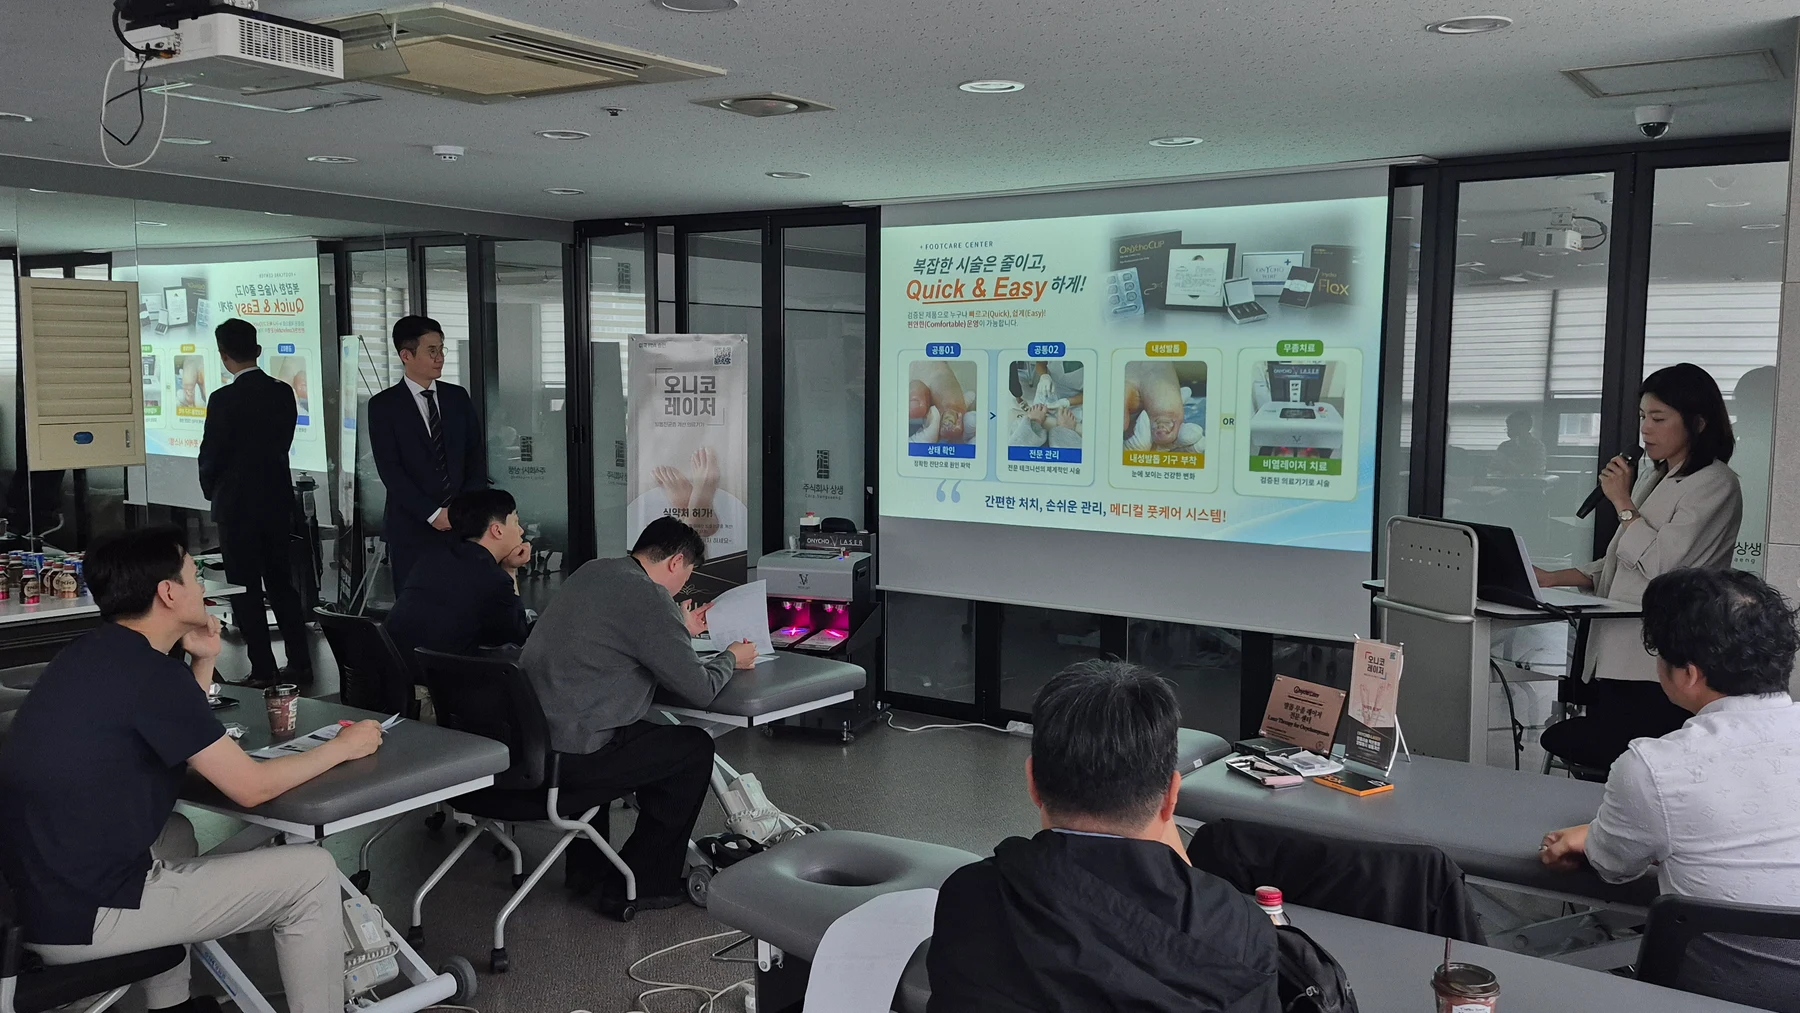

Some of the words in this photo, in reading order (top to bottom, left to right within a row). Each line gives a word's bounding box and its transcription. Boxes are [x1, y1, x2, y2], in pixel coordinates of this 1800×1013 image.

[925, 242, 962, 250] FOOTCARE
[913, 257, 953, 275] 복잡한
[956, 255, 997, 274] 시술은
[1000, 253, 1046, 273] 줄이고,
[906, 278, 966, 301] Quick
[972, 277, 986, 298] &
[994, 276, 1048, 302] Easy
[1051, 275, 1087, 294] 하게!
[908, 311, 925, 319] 검증된
[925, 311, 949, 319] 제품으로
[950, 310, 968, 318] 누구나
[986, 319, 1019, 328] 가능합니다.
[932, 345, 955, 354] 공통01
[1034, 345, 1059, 354] 공통02
[1151, 344, 1180, 353] 내성발톱
[1283, 343, 1316, 353] 무좀치료
[664, 375, 717, 394] 오니코
[664, 397, 716, 416] 레이저
[1222, 417, 1234, 426] OR
[927, 445, 941, 454] 상태
[942, 446, 955, 455] 확인
[1028, 449, 1044, 459] 전문
[1045, 450, 1060, 460] 관리
[1129, 454, 1160, 464] 내성발톱
[1162, 455, 1178, 464] 기구
[1181, 455, 1197, 466] 부착
[1262, 459, 1307, 471] 비열레이저
[1309, 460, 1328, 471] 치료
[1008, 464, 1018, 472] 전문
[1019, 465, 1046, 473] 테크니션의
[1046, 466, 1068, 474] 체계적인
[1131, 470, 1143, 478] 눈에
[1144, 471, 1162, 479] 보이는
[1163, 471, 1182, 480] 건강한
[1183, 472, 1195, 480] 변화
[1261, 476, 1280, 485] 검증된
[1281, 477, 1315, 487] 의료기기로
[1316, 478, 1330, 487] 시술
[803, 483, 829, 493] 주식회사
[830, 485, 844, 495] 상생
[663, 508, 690, 518] 식약처
[692, 508, 713, 518] 허가!
[985, 495, 1016, 510] 간편한
[1018, 497, 1043, 513] 처치,
[1045, 499, 1077, 514] 손쉬운
[1081, 501, 1107, 517] 관리,
[1110, 503, 1143, 518] 메디컬
[1147, 505, 1182, 520] 풋케어
[1185, 508, 1227, 523] 시스템!
[1734, 542, 1761, 556] 상생
[1368, 655, 1385, 667] 오니코
[1367, 664, 1384, 675] 레이저
